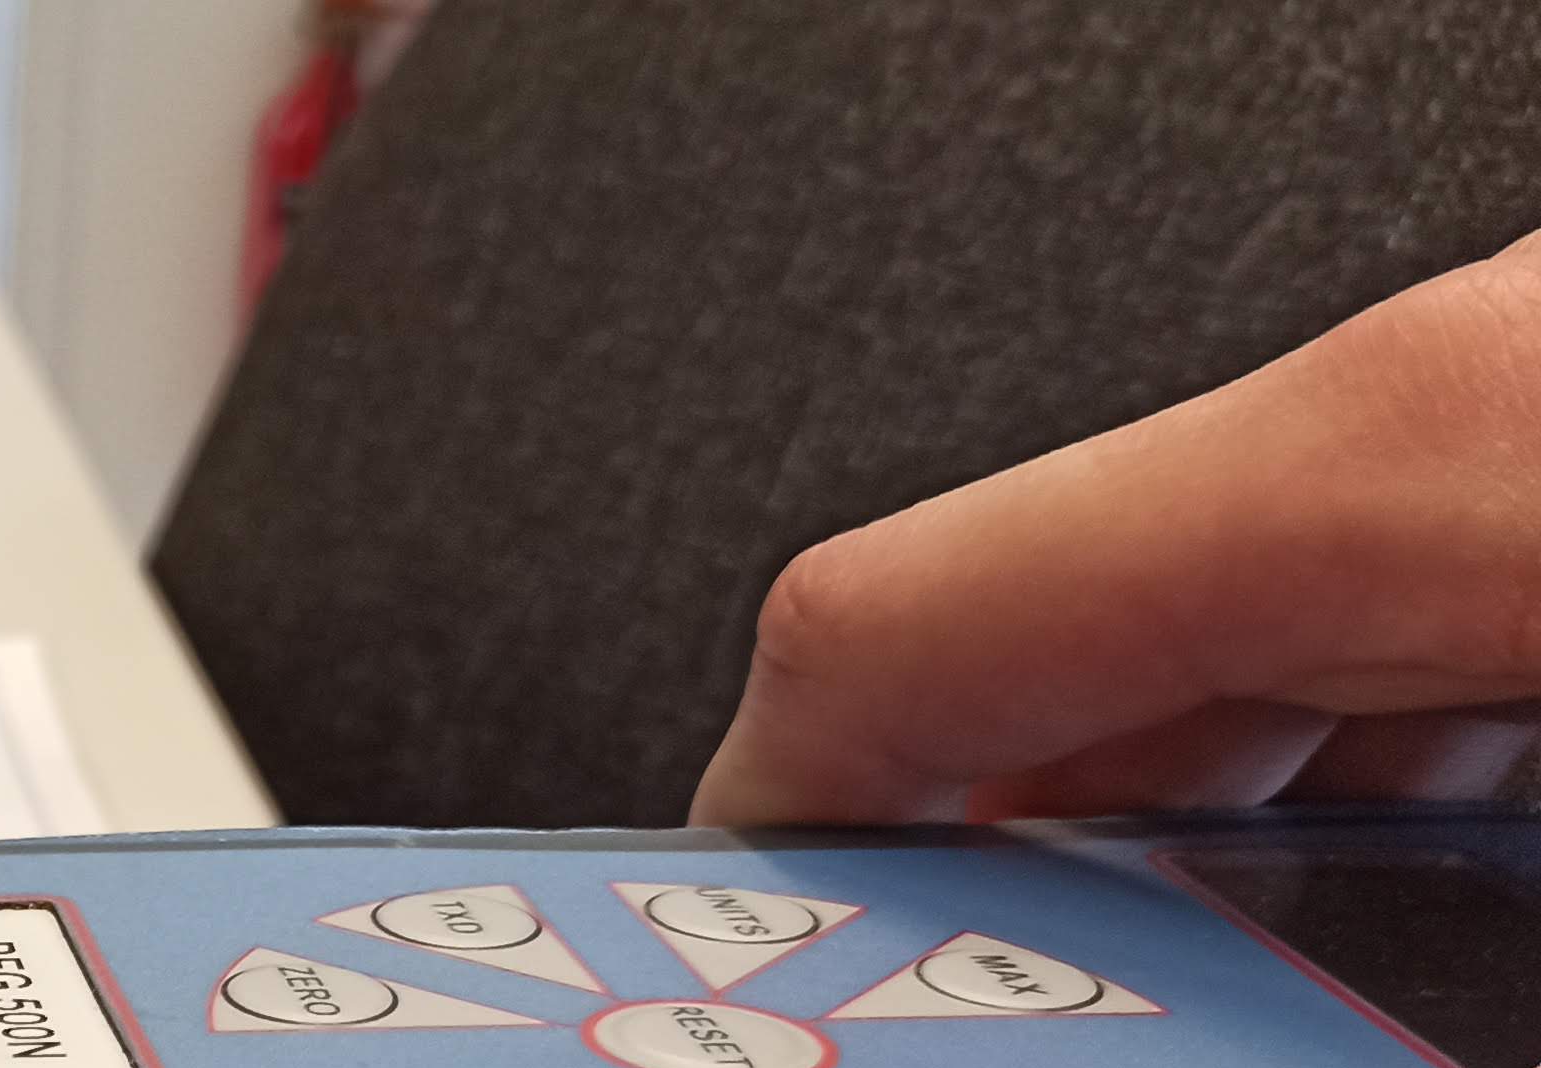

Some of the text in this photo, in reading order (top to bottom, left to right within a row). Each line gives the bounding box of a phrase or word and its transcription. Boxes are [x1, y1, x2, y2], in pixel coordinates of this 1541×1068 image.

[429, 900, 485, 936] TXD
[695, 886, 771, 938] UNITS
[277, 966, 342, 1017] ZERO
[970, 953, 1050, 998] MAX
